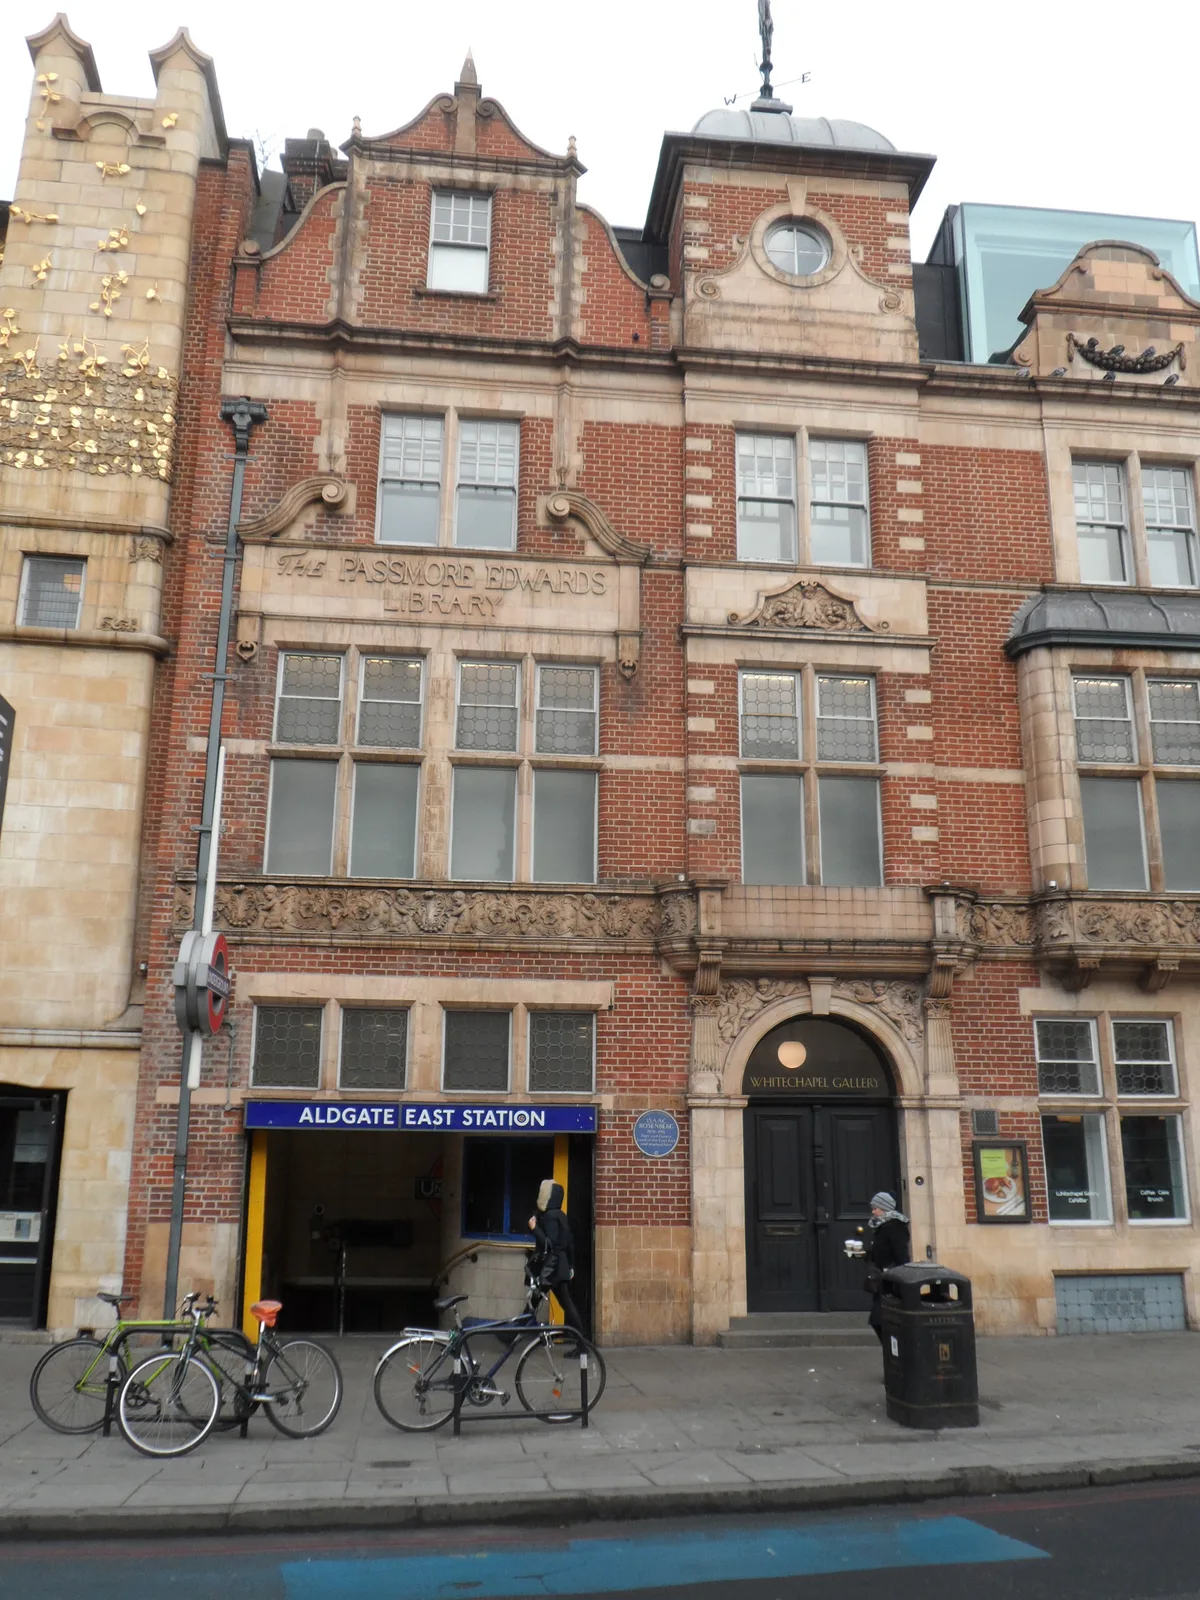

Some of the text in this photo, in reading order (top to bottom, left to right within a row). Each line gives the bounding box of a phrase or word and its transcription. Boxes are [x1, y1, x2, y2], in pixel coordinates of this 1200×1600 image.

[277, 550, 607, 596] THE PASSMORE EDWARDS
[383, 589, 503, 618] LIBRARY
[750, 1076, 879, 1089] WHITECHAPEL GALLERY
[298, 1107, 546, 1127] ALDGATE EAST STATION
